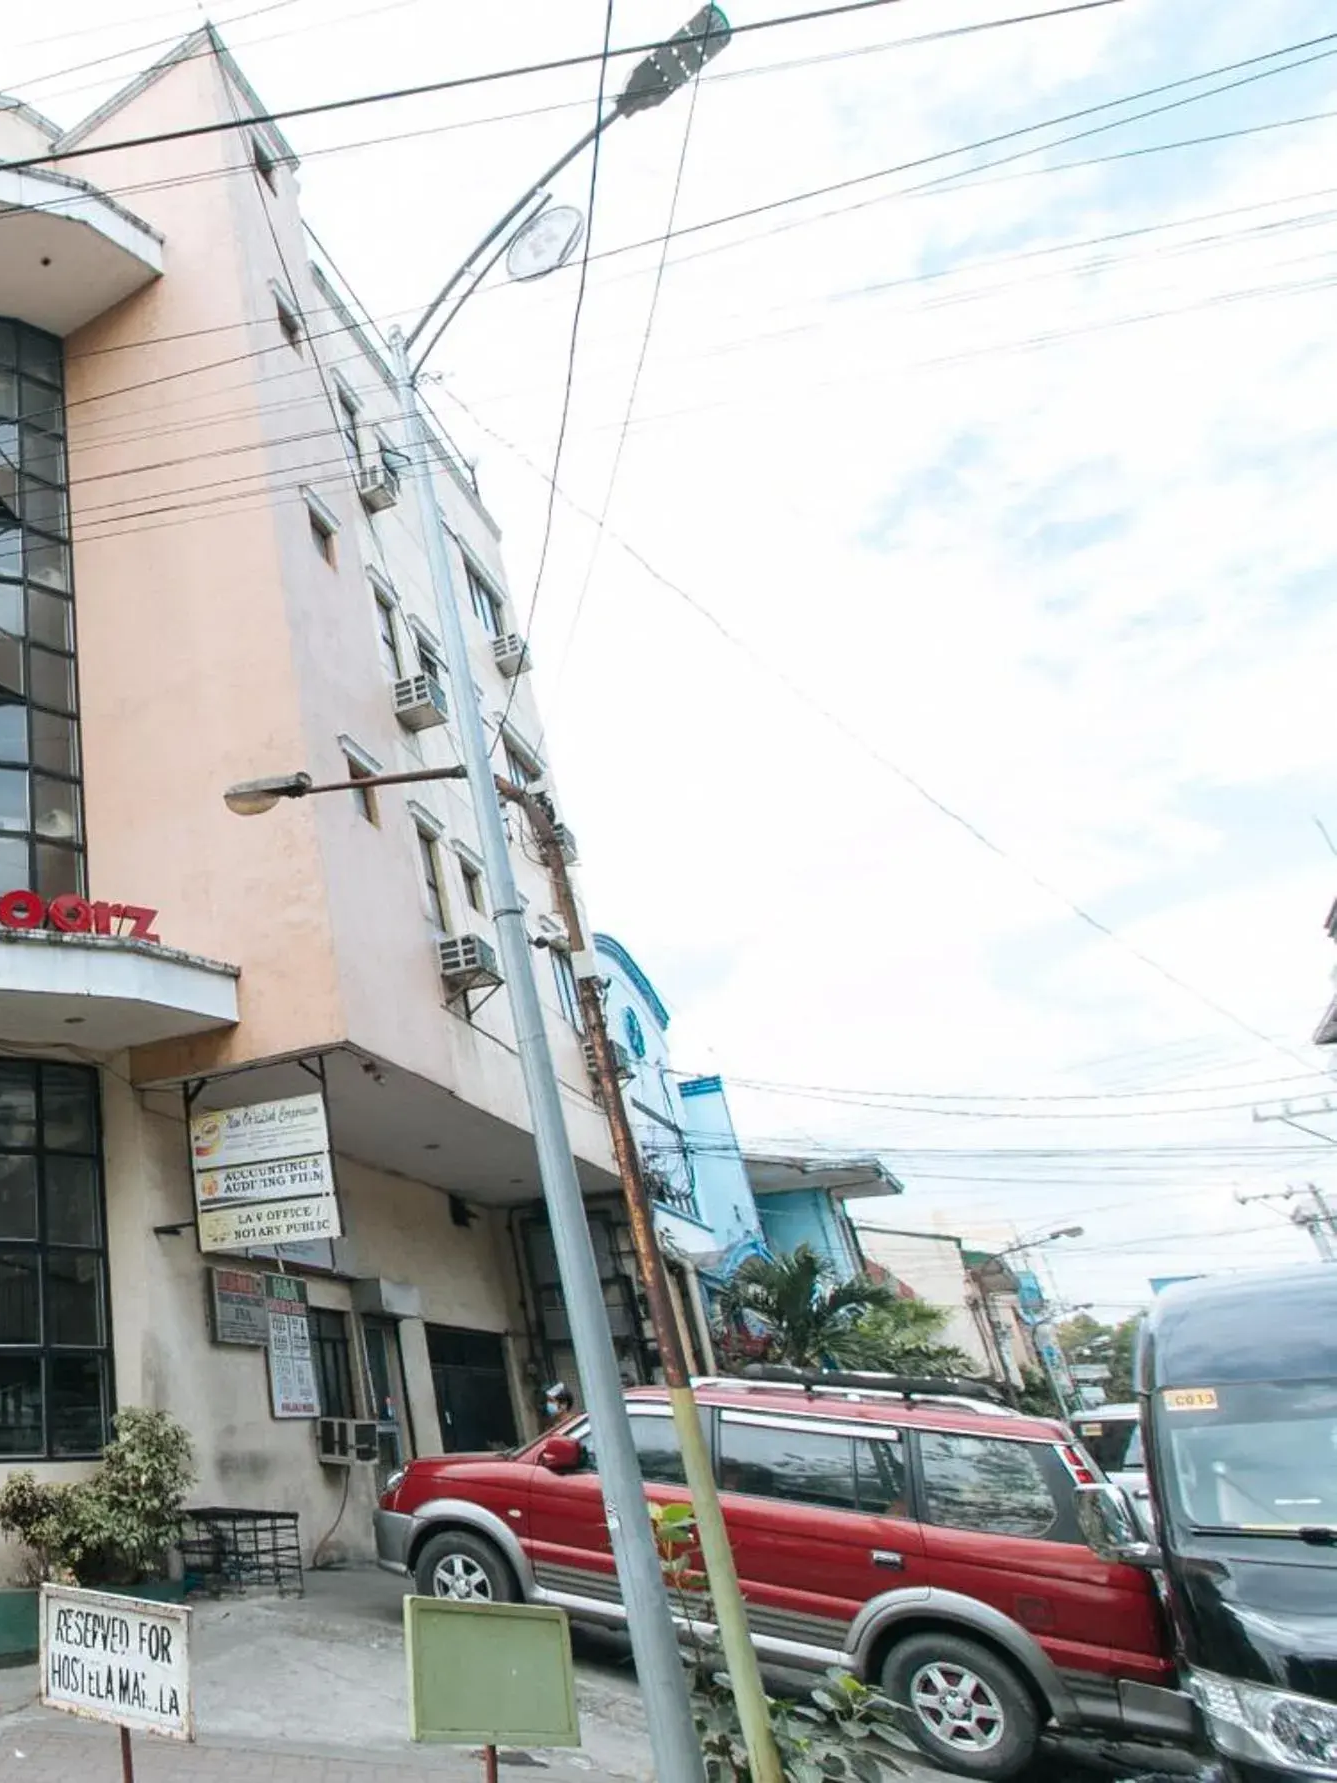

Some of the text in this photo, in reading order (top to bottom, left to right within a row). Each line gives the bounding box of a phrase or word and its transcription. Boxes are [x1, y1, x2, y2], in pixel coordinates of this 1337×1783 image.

[266, 1206, 312, 1221] OFFICE
[55, 1608, 173, 1665] RESERVED FOR
